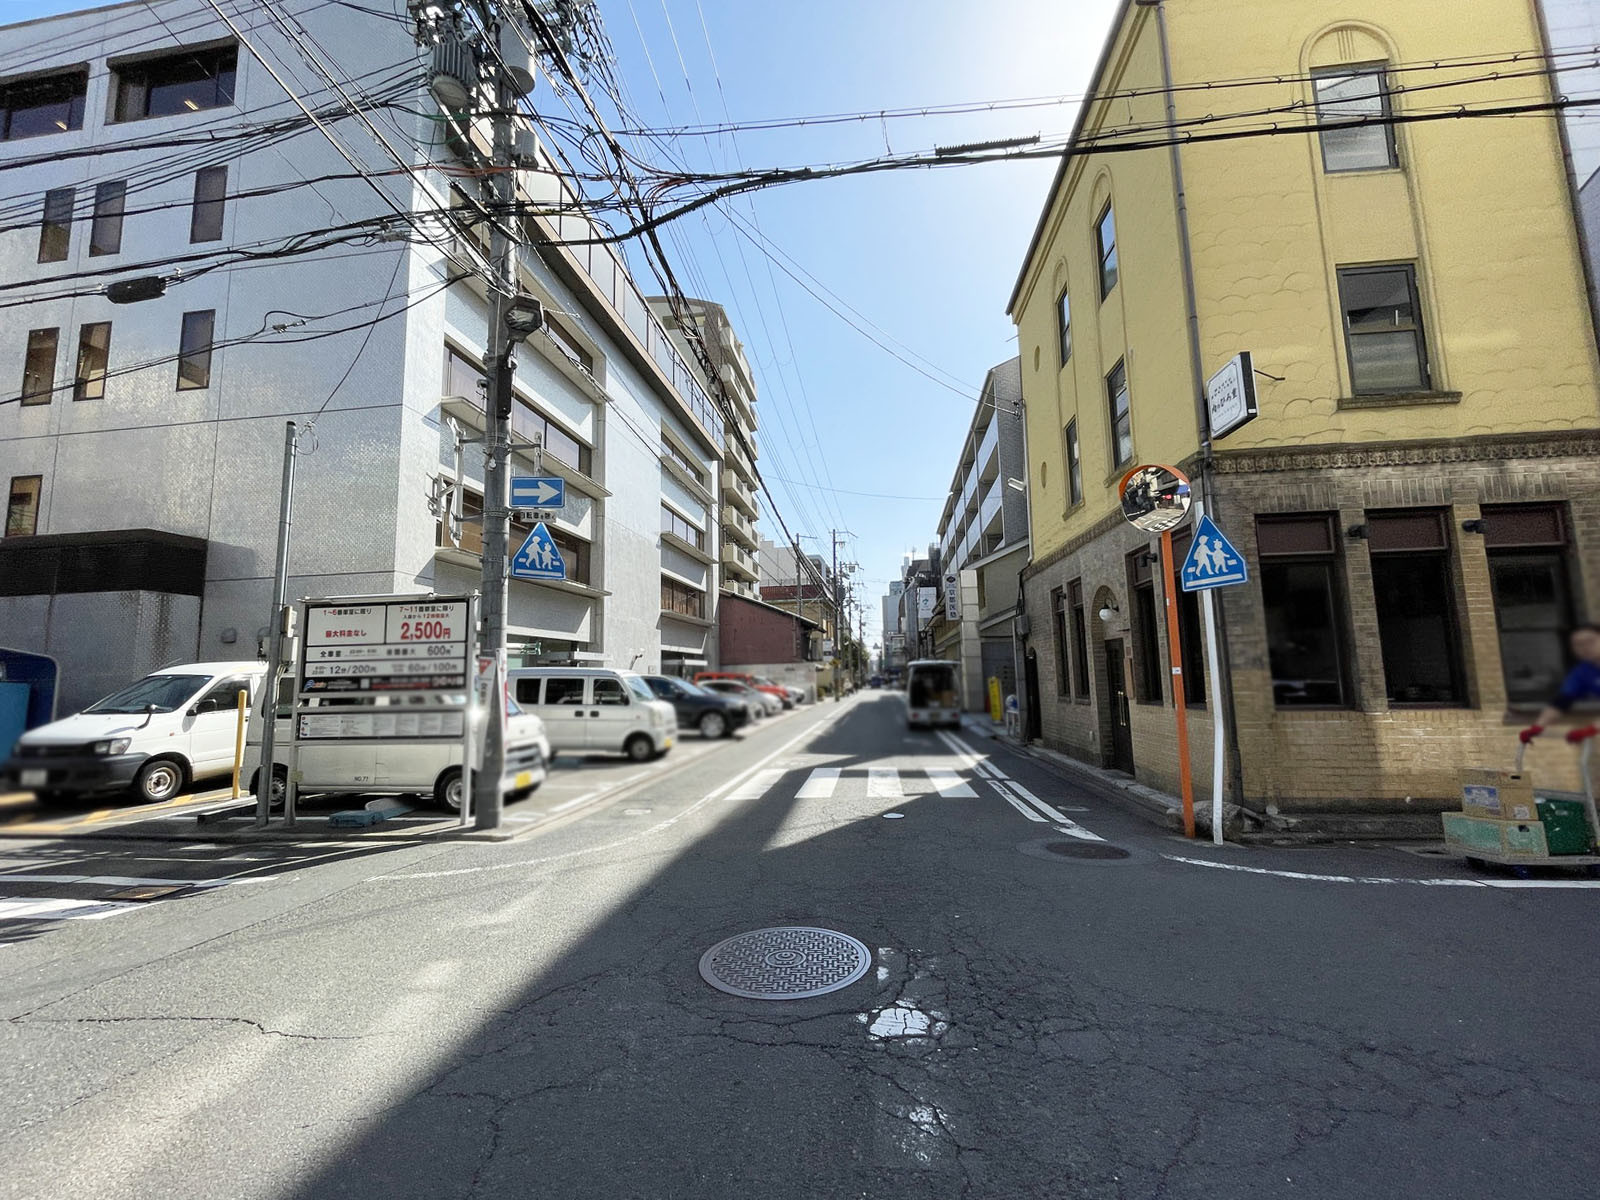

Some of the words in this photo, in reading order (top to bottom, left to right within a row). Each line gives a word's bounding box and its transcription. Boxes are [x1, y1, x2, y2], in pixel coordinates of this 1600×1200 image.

[325, 629, 367, 638] 最大料金なし
[400, 621, 451, 640] 2,500円
